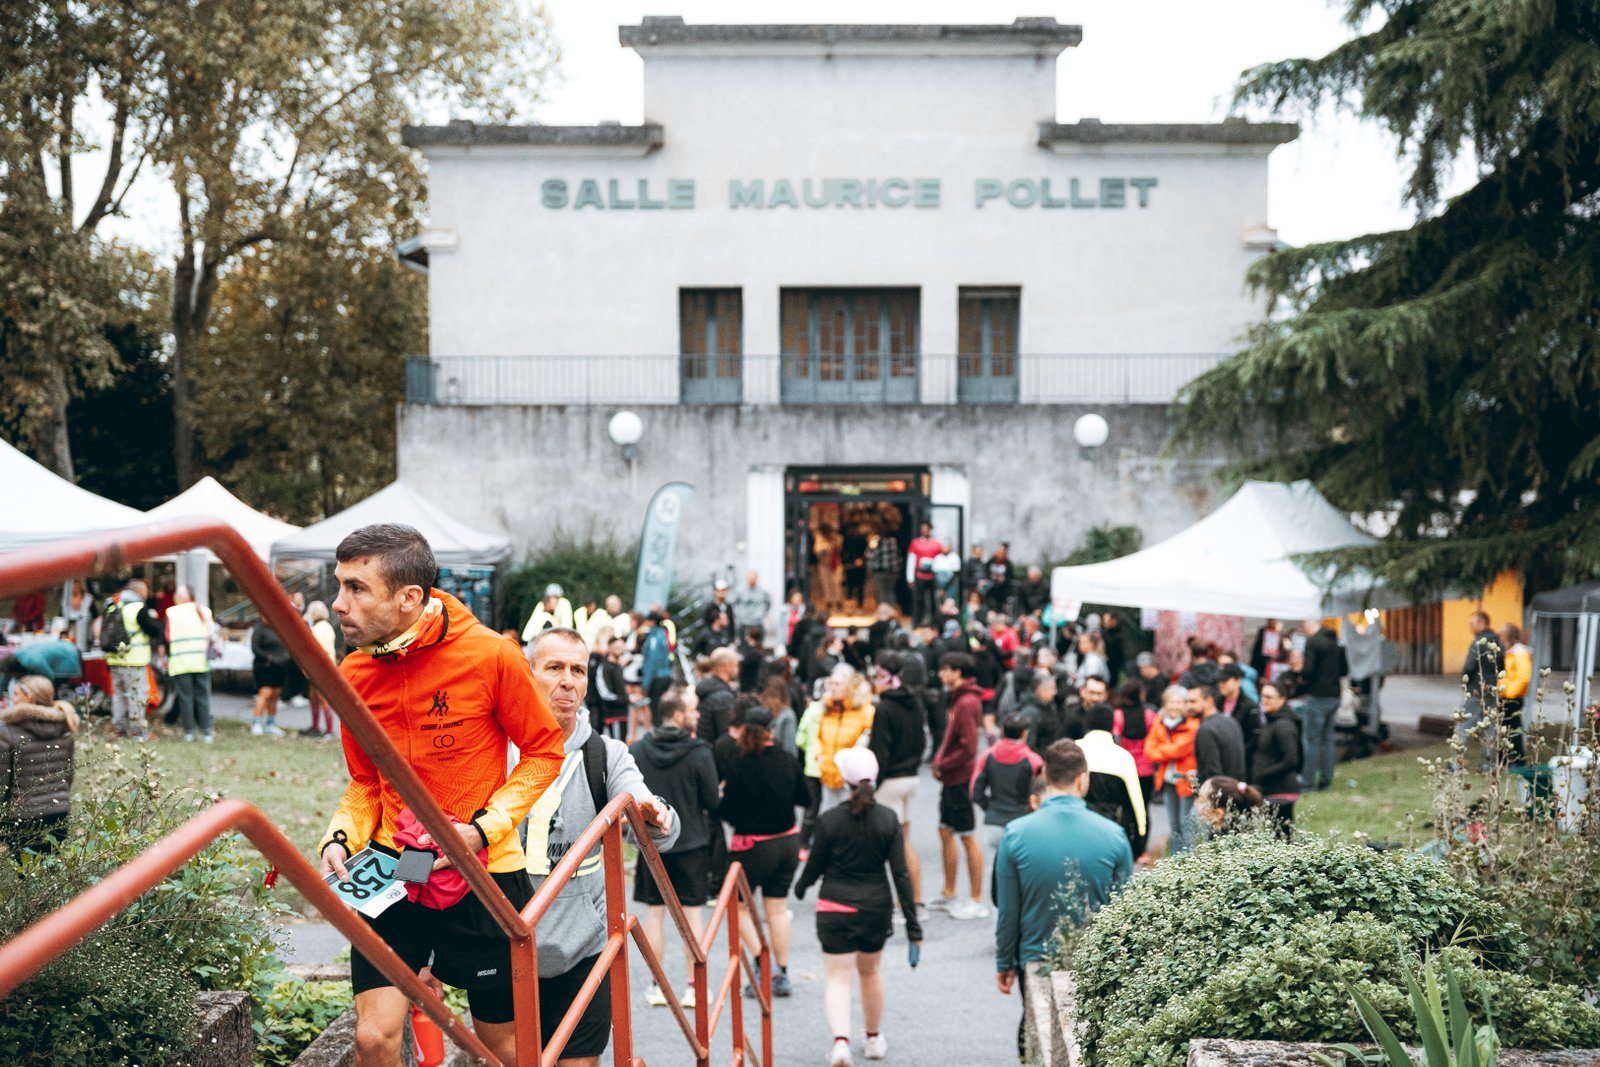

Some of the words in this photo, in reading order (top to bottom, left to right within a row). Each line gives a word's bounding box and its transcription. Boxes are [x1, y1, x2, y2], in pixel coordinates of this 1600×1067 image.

[540, 178, 696, 210] SALLE
[729, 178, 941, 209] MAURICE
[974, 177, 1159, 210] POLLET
[338, 857, 395, 900] 258
